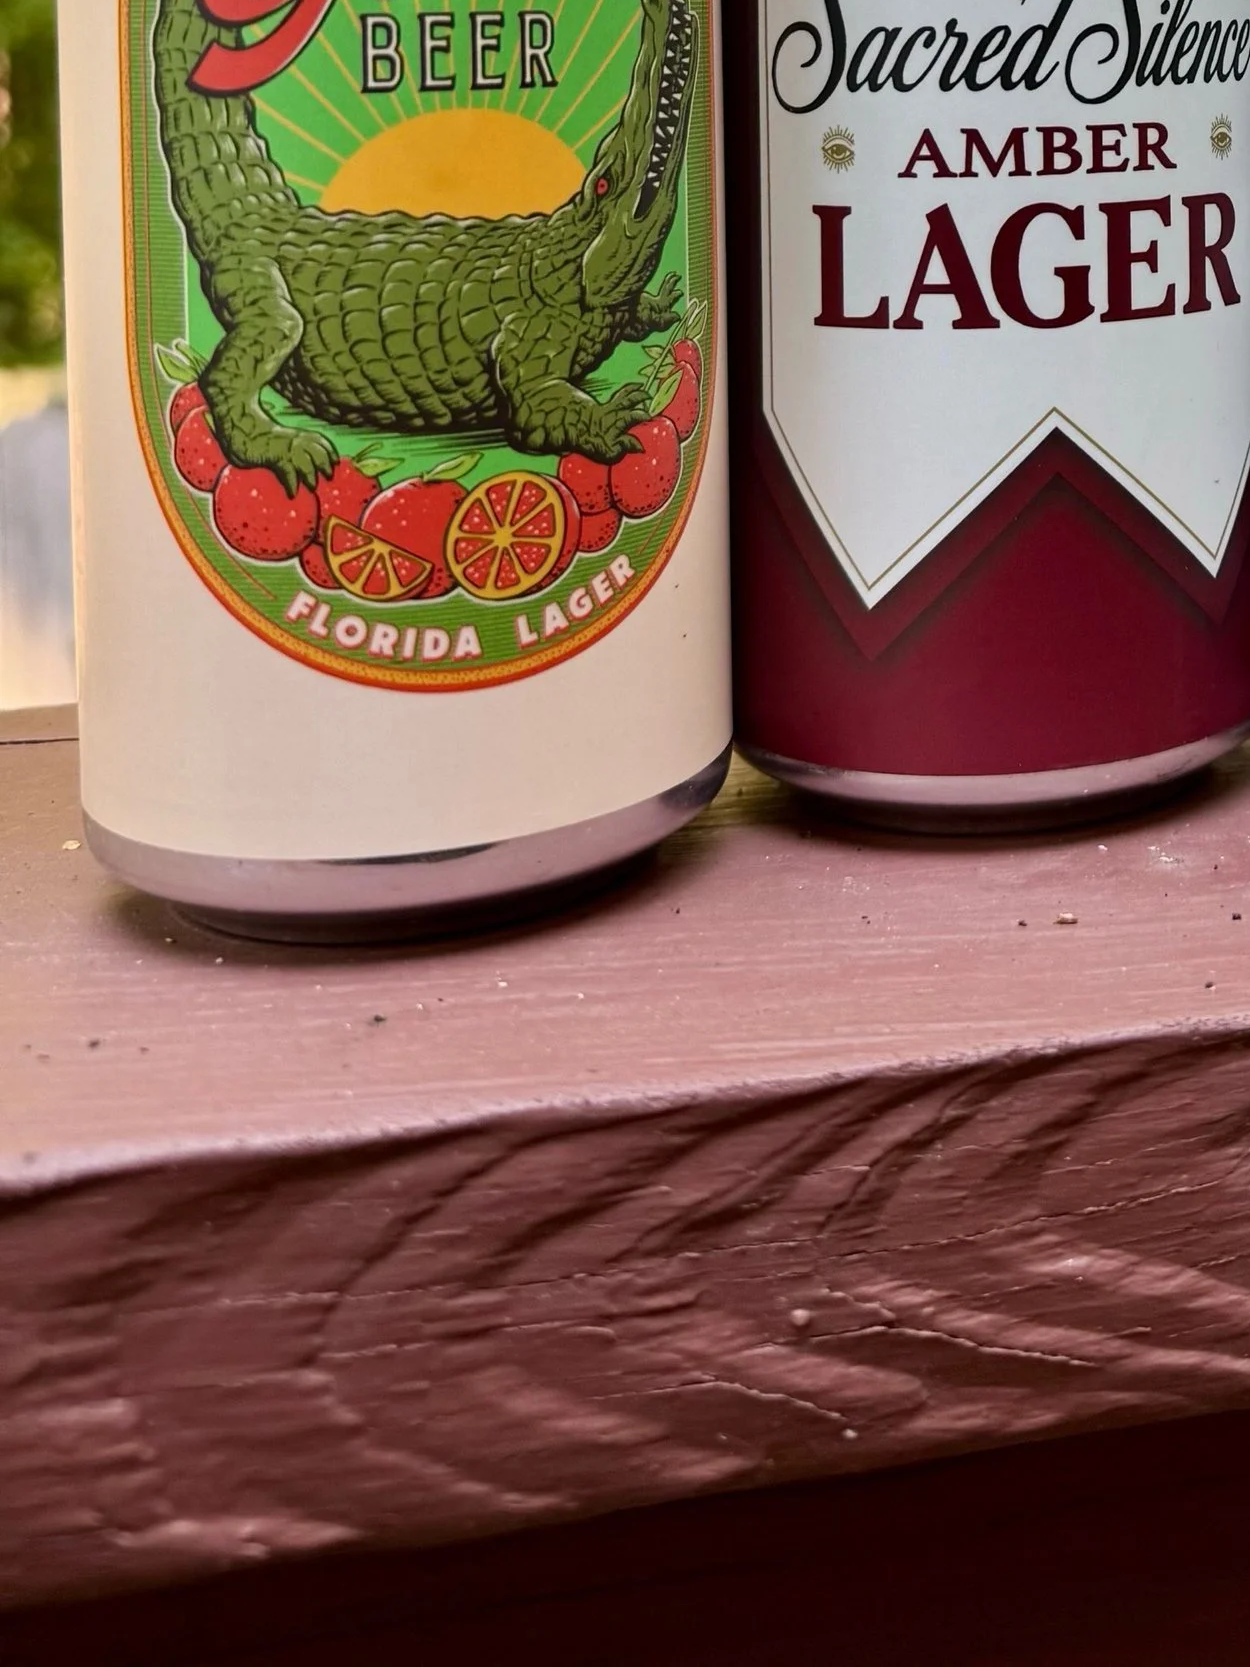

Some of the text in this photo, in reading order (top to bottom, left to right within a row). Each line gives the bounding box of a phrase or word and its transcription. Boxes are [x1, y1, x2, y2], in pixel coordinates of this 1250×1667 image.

[359, 10, 557, 94] BEER
[897, 121, 1177, 178] AMBER
[812, 192, 1241, 330] LAGER
[286, 551, 637, 661] FLORIDA LAGER
